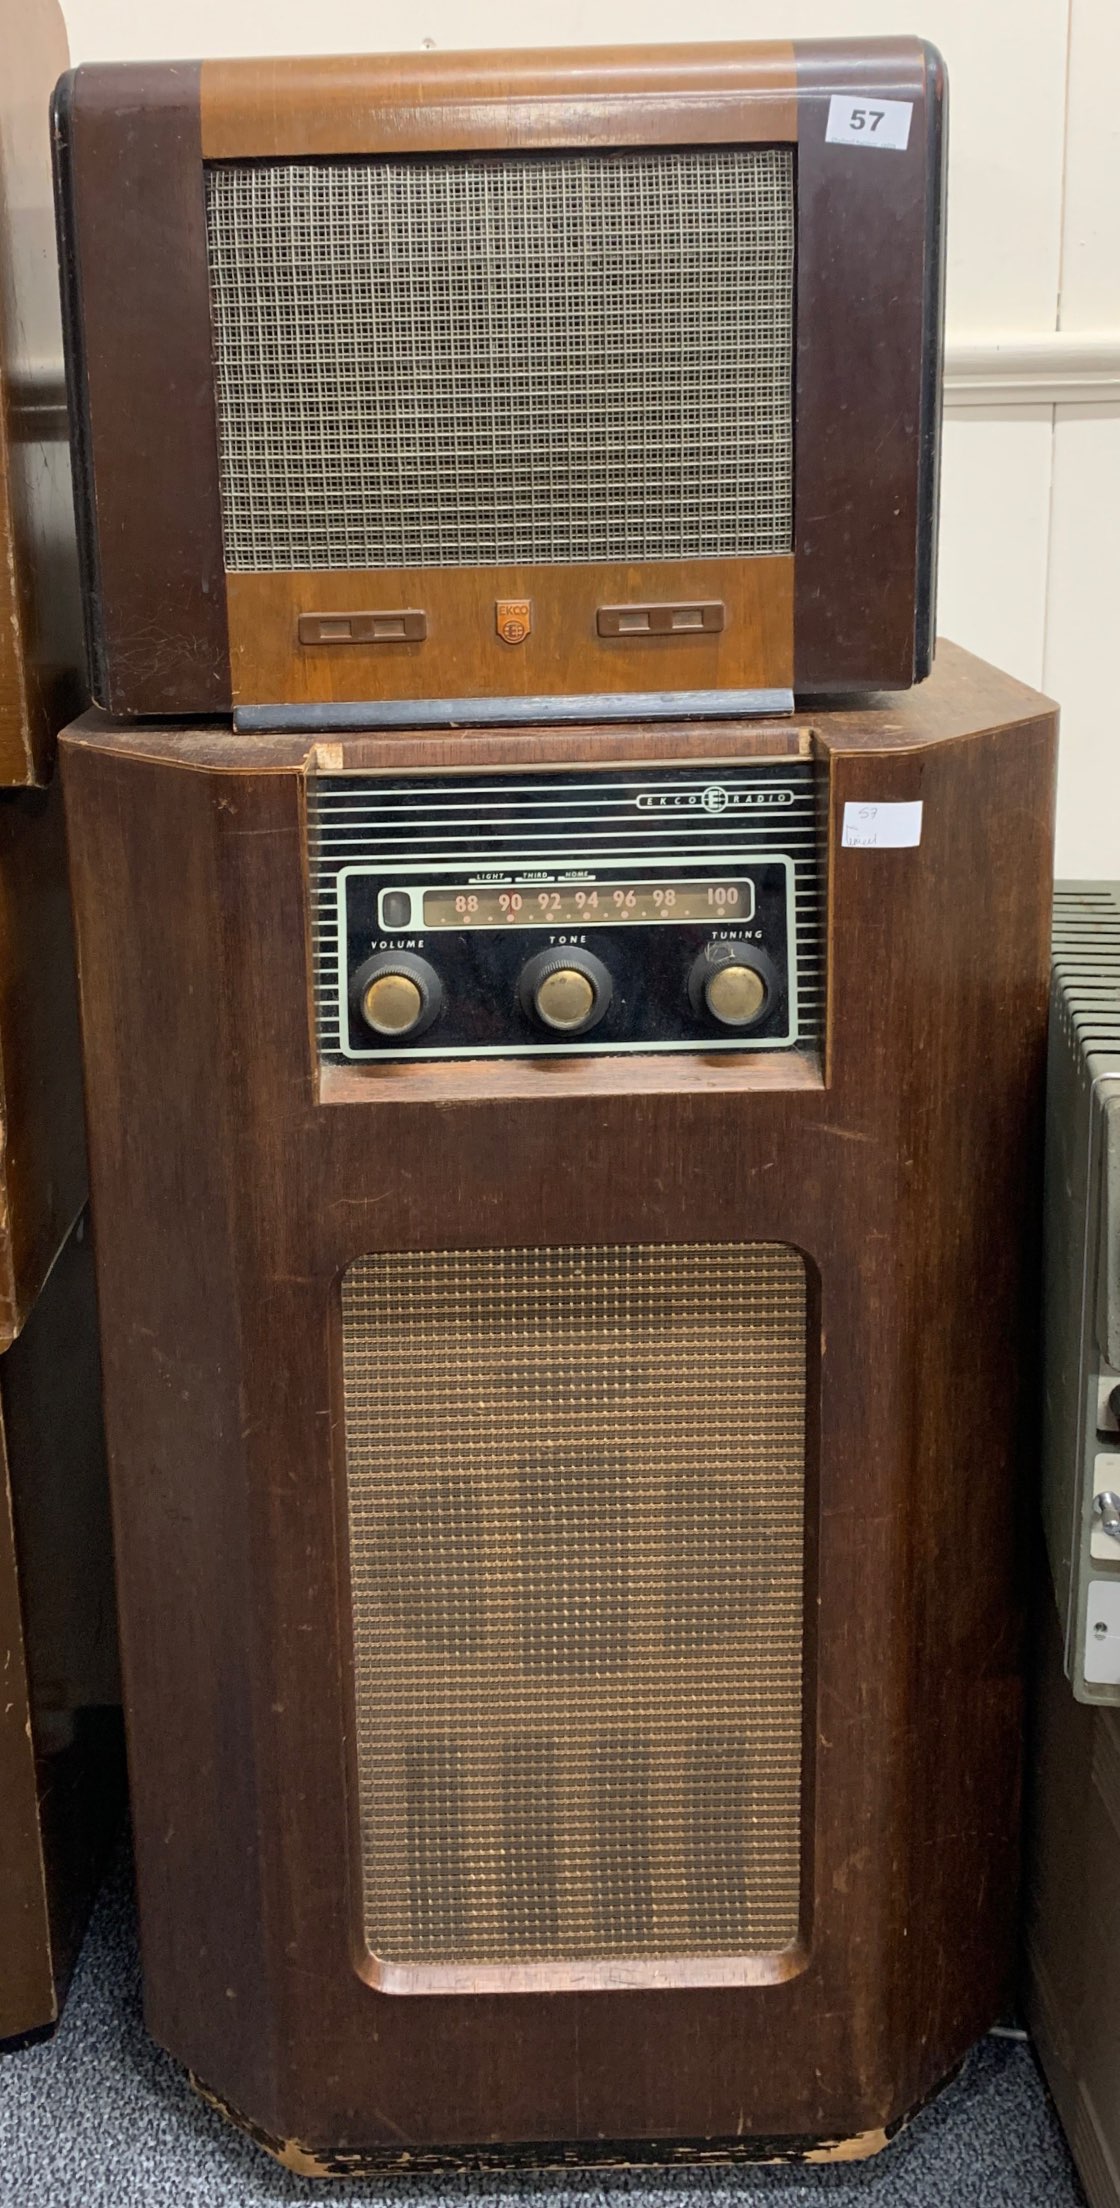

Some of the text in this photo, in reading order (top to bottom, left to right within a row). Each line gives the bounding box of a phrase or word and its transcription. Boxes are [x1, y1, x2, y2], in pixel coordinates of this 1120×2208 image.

[849, 109, 885, 132] 57
[499, 605, 529, 616] EKCO
[646, 796, 697, 806] EKCO
[733, 794, 786, 804] RADIO
[455, 887, 739, 912] 88 90 92 94 96 98 100
[549, 935, 587, 944] TONE
[712, 930, 763, 940] TUNING
[371, 939, 425, 949] VOLUME
